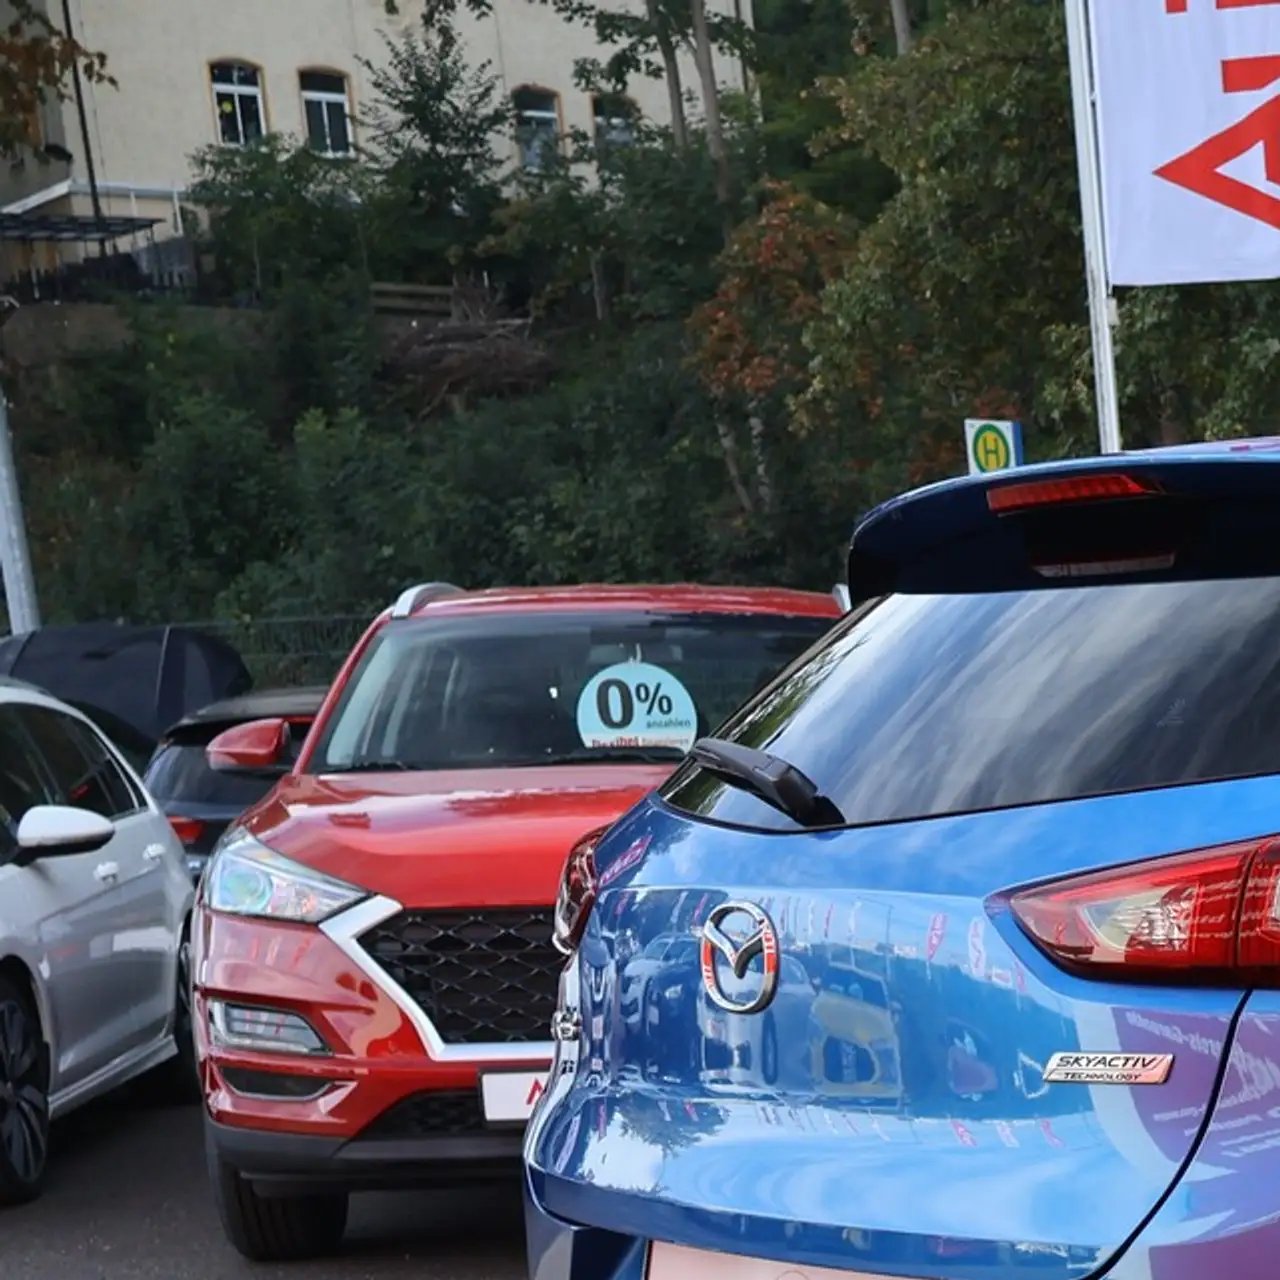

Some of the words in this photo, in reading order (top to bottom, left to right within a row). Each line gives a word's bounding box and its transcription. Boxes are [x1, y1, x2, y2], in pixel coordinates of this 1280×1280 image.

[597, 679, 672, 729] 0%
[1057, 1055, 1157, 1068] SKYACTIV
[1063, 1071, 1142, 1081] TECHNOLOGY
